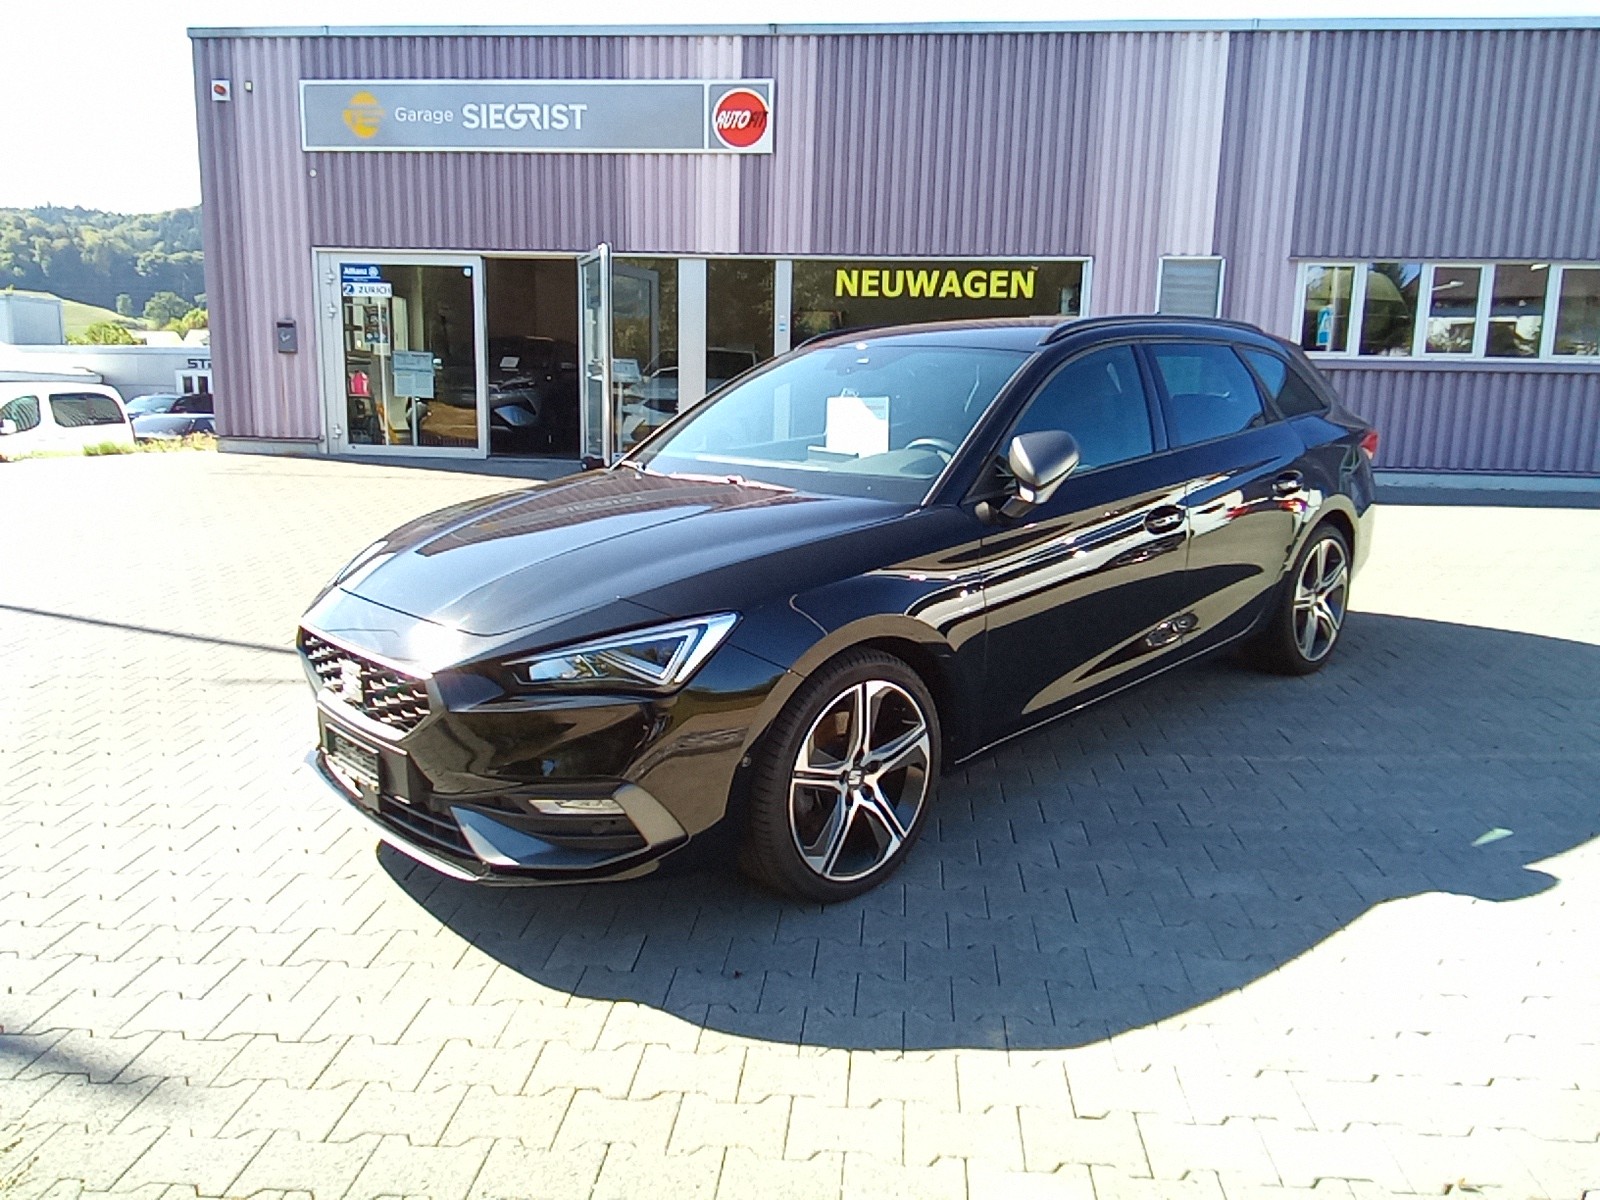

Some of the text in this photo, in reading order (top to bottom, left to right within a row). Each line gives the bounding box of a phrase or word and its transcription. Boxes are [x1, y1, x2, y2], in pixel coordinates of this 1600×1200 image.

[394, 103, 588, 130] Garage SIEGRIST
[835, 269, 1035, 299] NEUWAGEN
